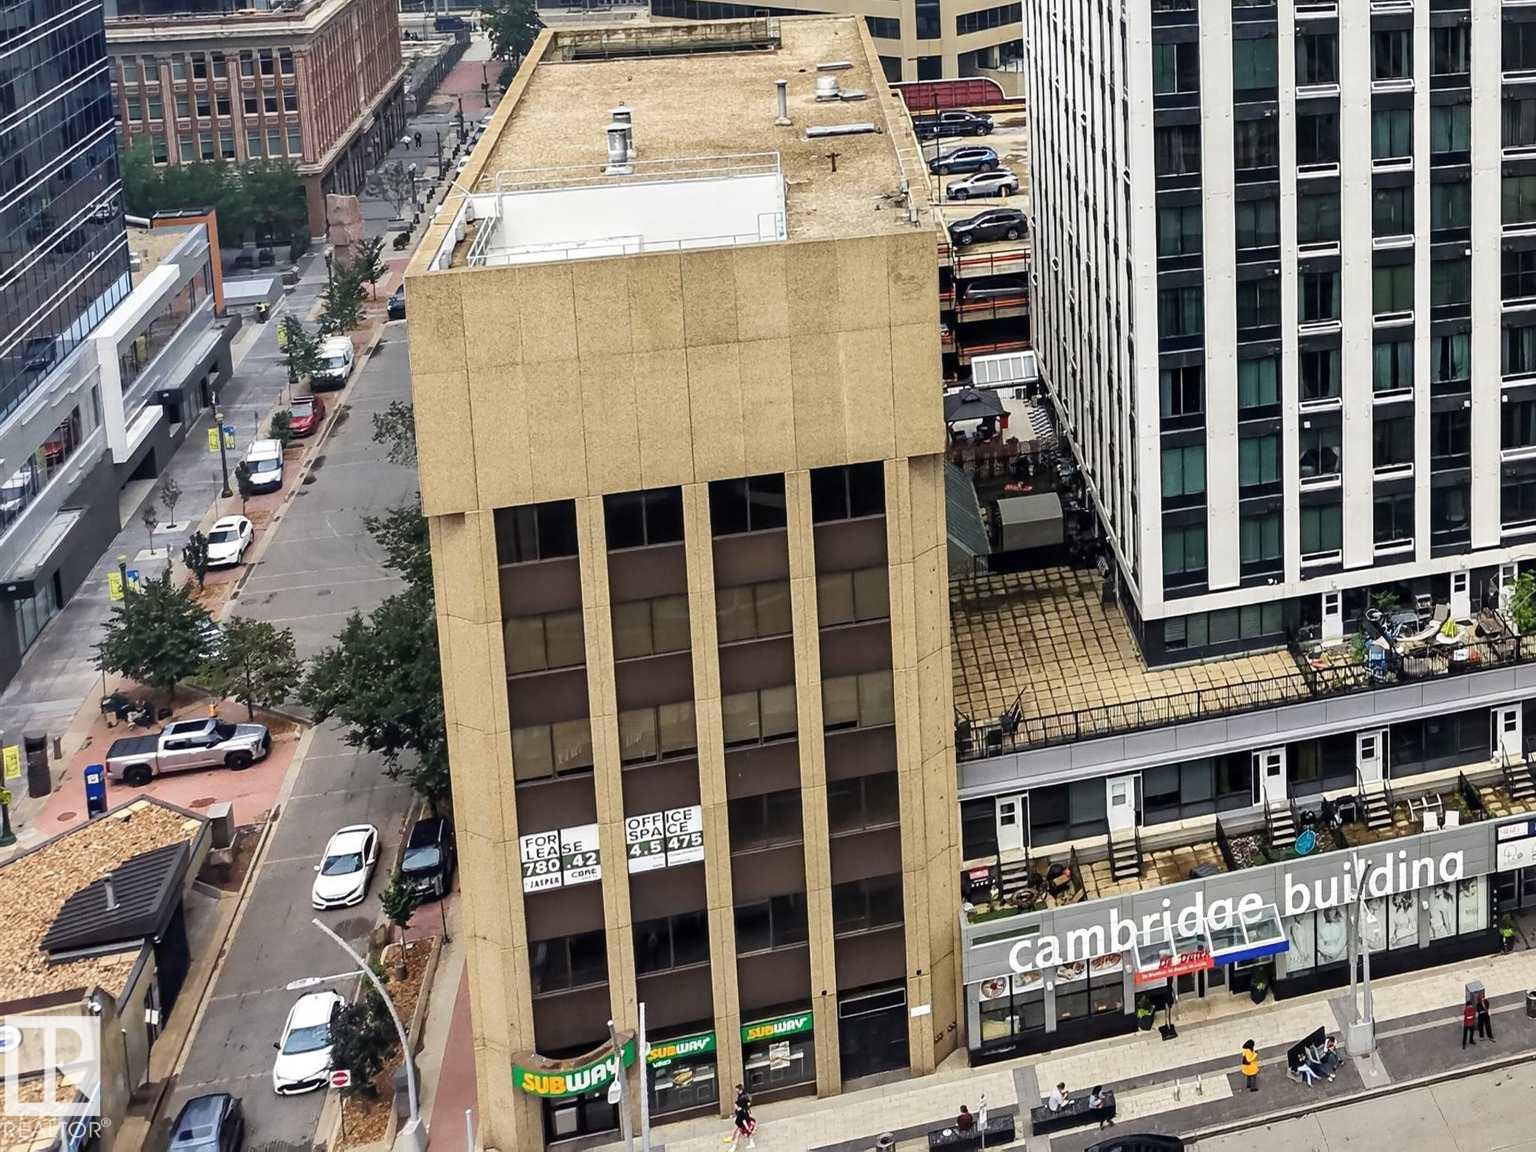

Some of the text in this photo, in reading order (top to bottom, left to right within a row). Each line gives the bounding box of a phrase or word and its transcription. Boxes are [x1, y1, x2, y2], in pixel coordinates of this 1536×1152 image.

[525, 834, 558, 849] FOR
[529, 876, 560, 889] JASPER
[1008, 849, 1465, 974] cambridge building
[746, 1017, 807, 1040] SUBWAY
[649, 1038, 710, 1061] SUBWAY
[522, 1052, 622, 1094] SUBWAY
